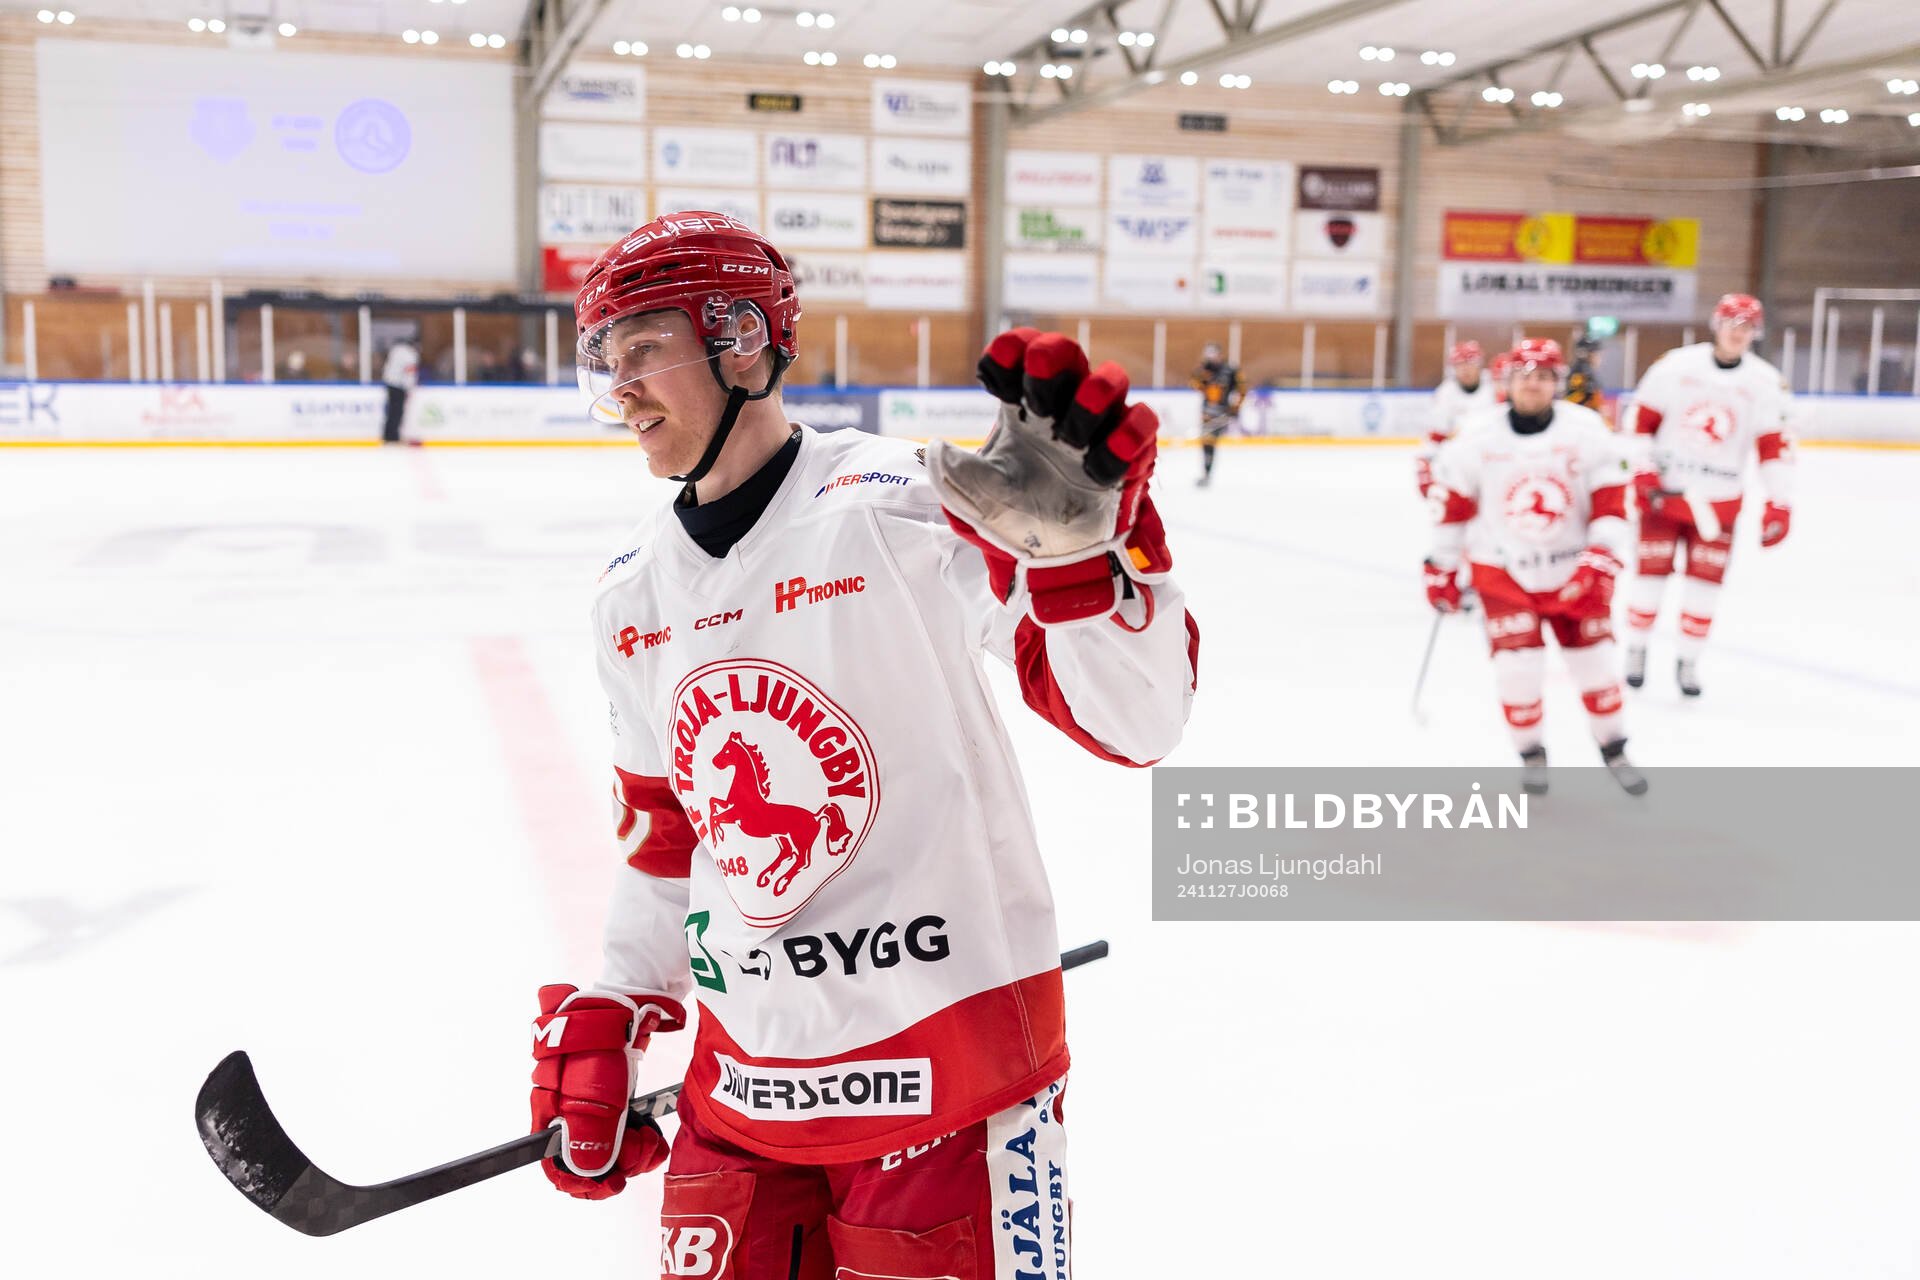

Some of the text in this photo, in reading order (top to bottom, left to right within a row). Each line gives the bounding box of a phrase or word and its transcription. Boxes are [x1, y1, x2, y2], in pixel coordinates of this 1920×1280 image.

[721, 262, 769, 276] CCM
[578, 280, 608, 314] CCM
[694, 608, 744, 631] CCM
[673, 673, 867, 800] TROJA-LJUNGBY
[782, 915, 951, 979] BYGG
